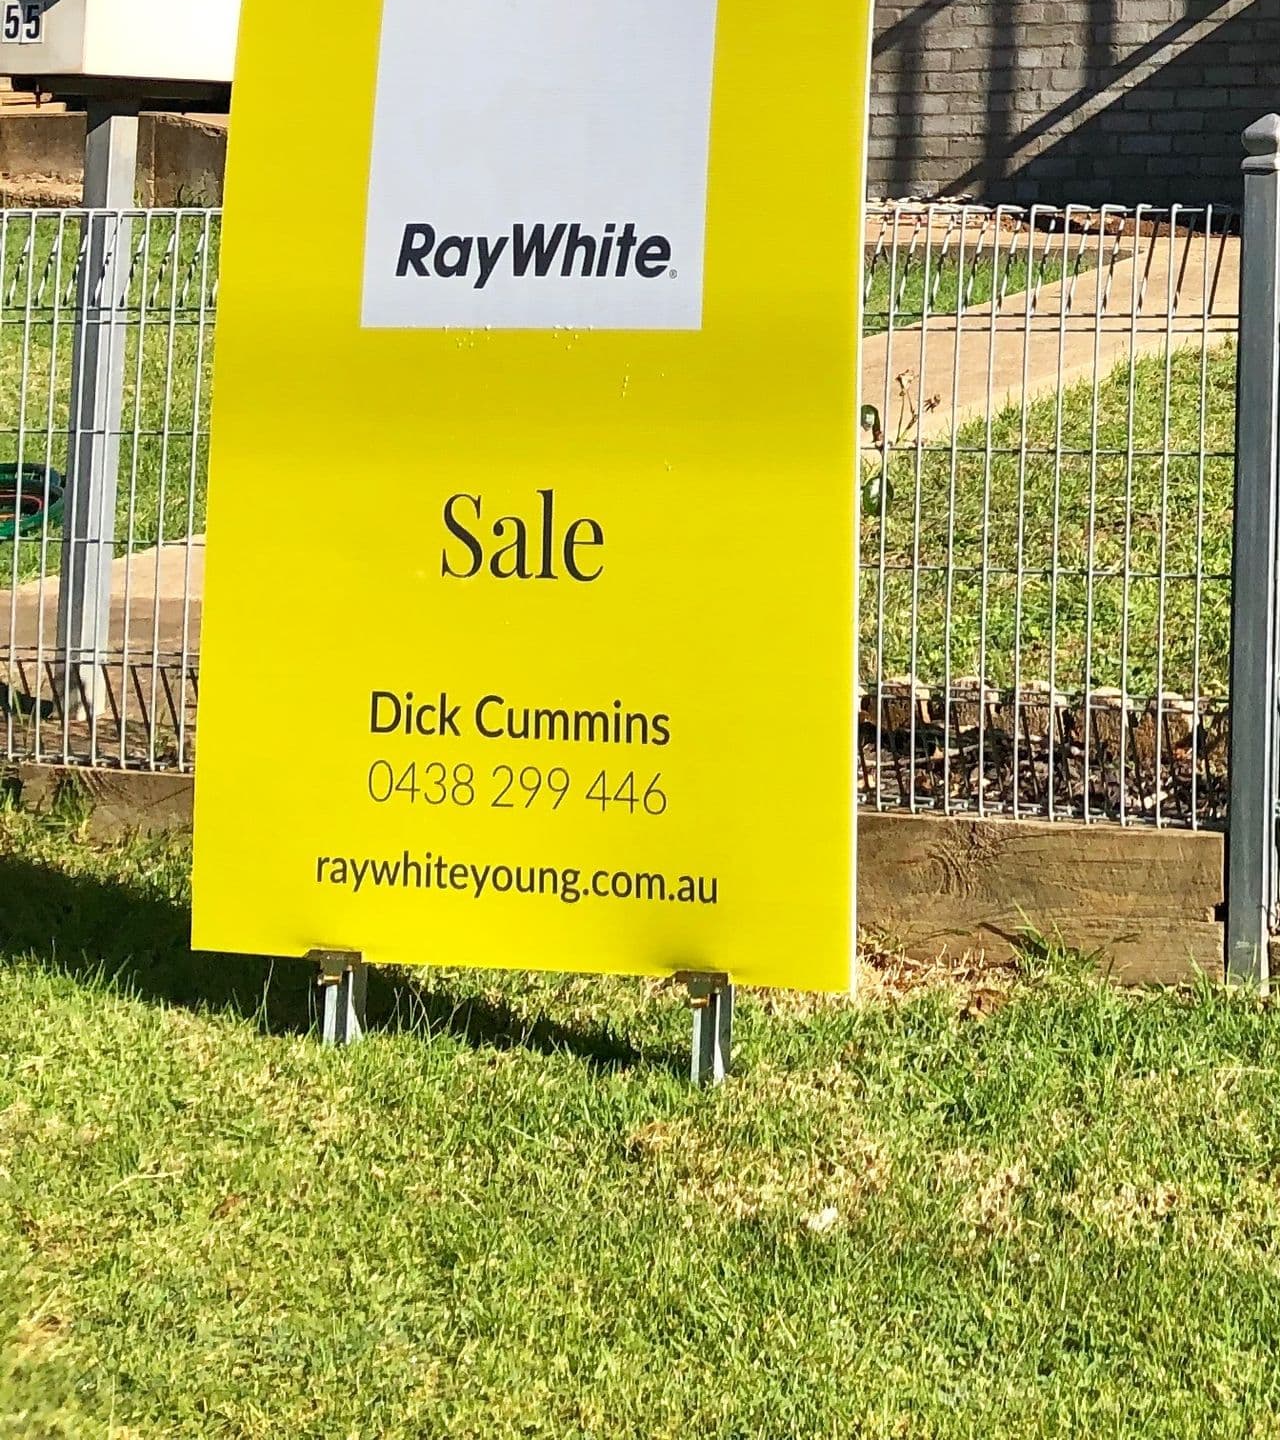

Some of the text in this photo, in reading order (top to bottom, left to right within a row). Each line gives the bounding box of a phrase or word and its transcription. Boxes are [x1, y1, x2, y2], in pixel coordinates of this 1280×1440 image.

[5, 4, 40, 39] 55
[395, 222, 672, 290] RayWhite
[441, 488, 604, 582] Sale
[370, 690, 671, 746] Dick Cummins
[368, 759, 667, 816] 0438 299 446
[316, 850, 718, 905] raywhiteyoung.com.au
